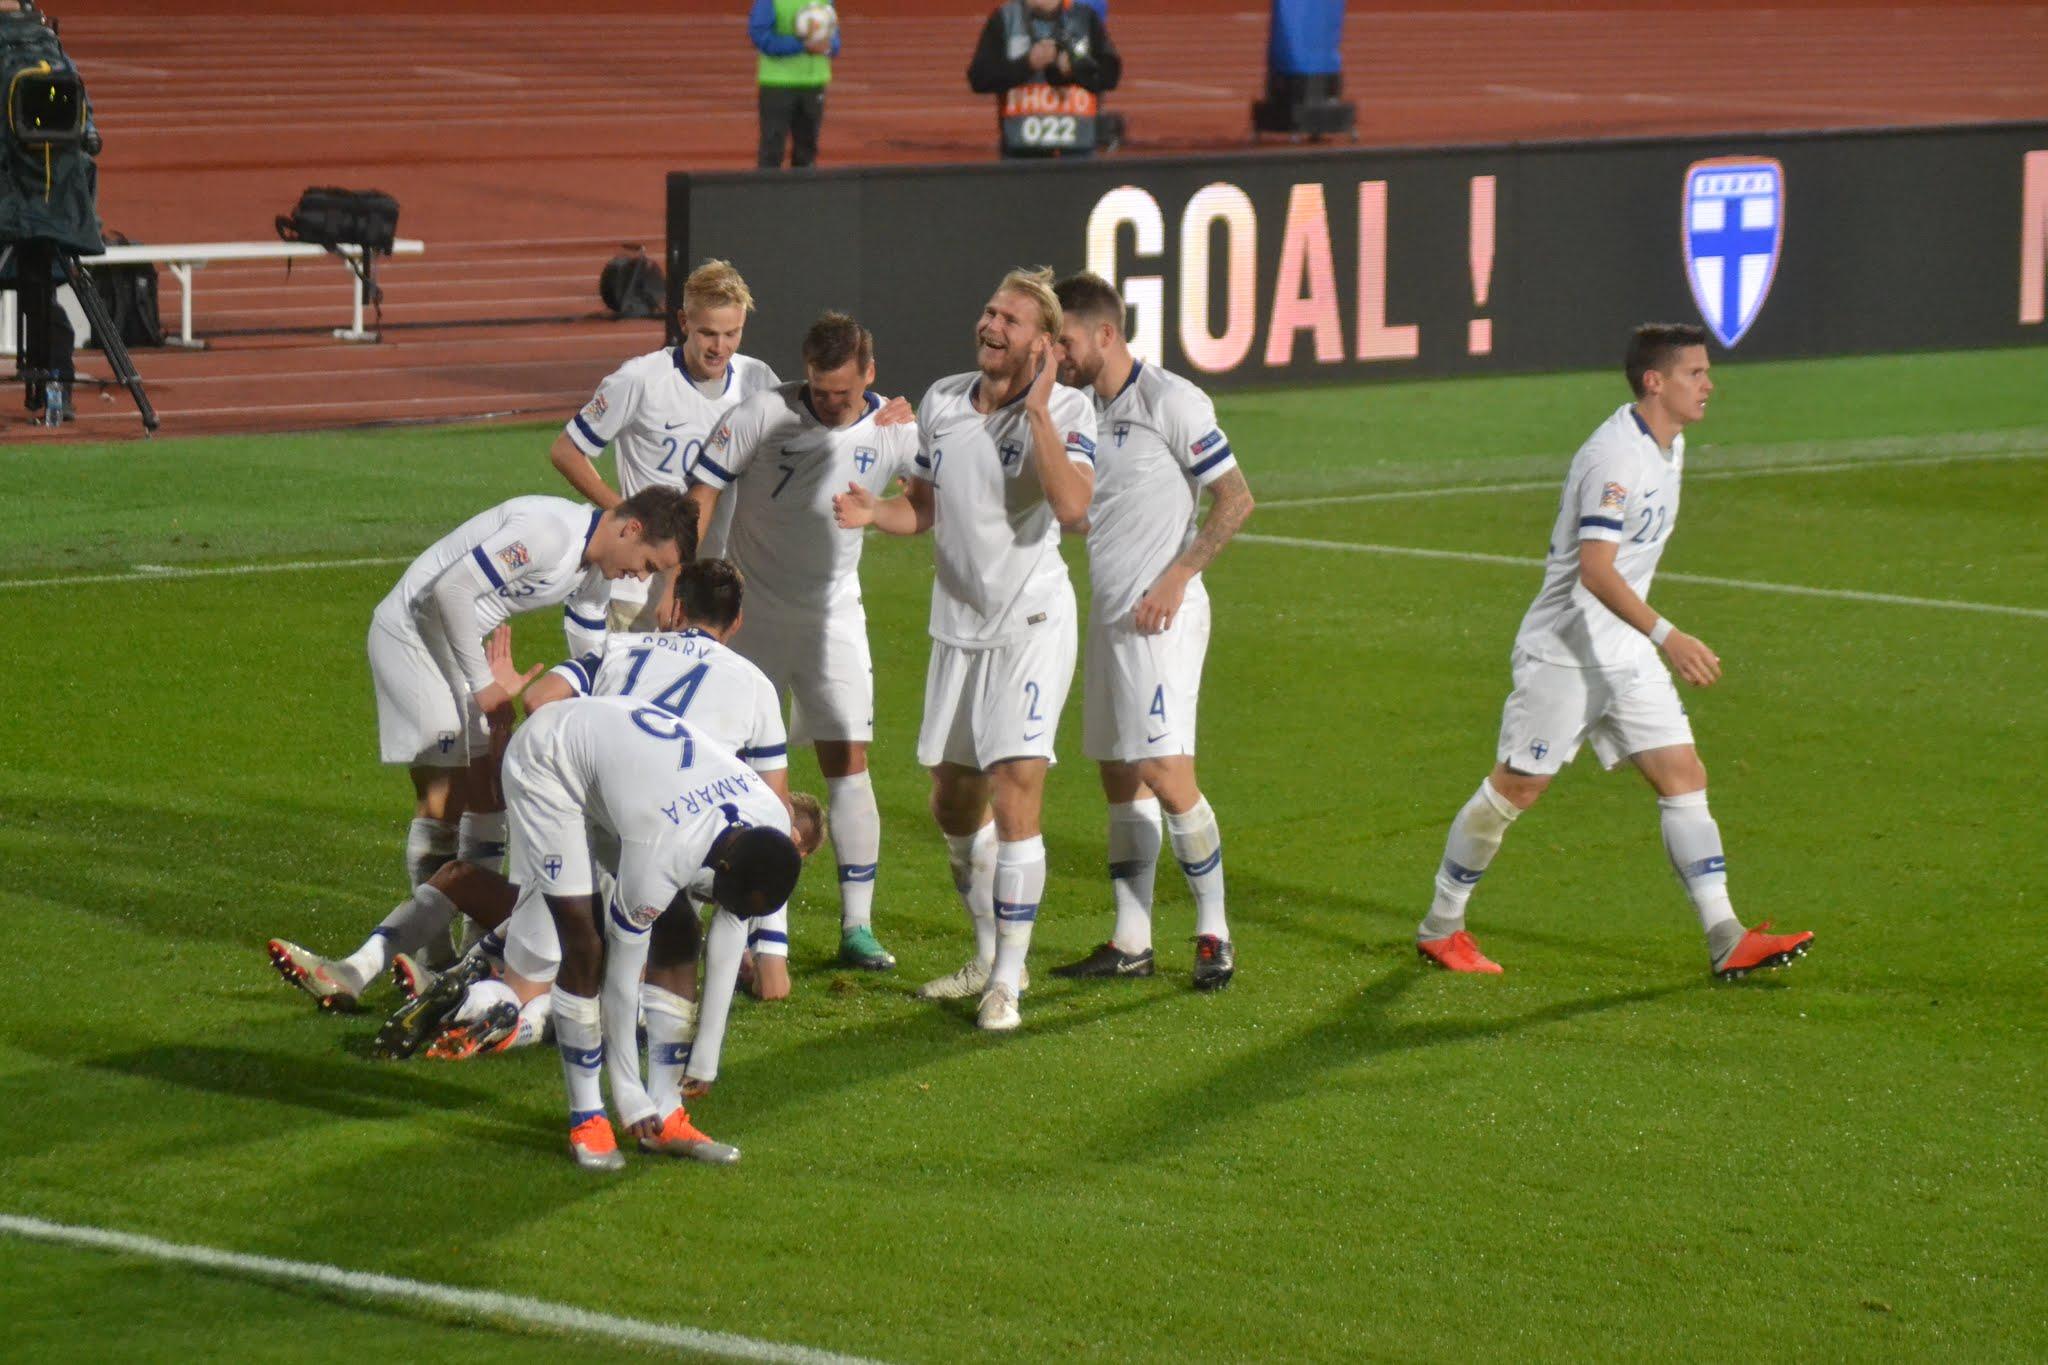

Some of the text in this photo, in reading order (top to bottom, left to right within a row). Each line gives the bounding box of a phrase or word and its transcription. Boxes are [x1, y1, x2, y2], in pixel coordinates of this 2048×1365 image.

[1022, 117, 1076, 143] 022
[1086, 175, 1497, 374] GOAL !
[656, 436, 704, 475] 20
[771, 464, 795, 498] 7
[619, 647, 711, 718] 14
[1023, 680, 1043, 721] 2
[1149, 683, 1167, 723] 4
[661, 772, 759, 825] AMARA
